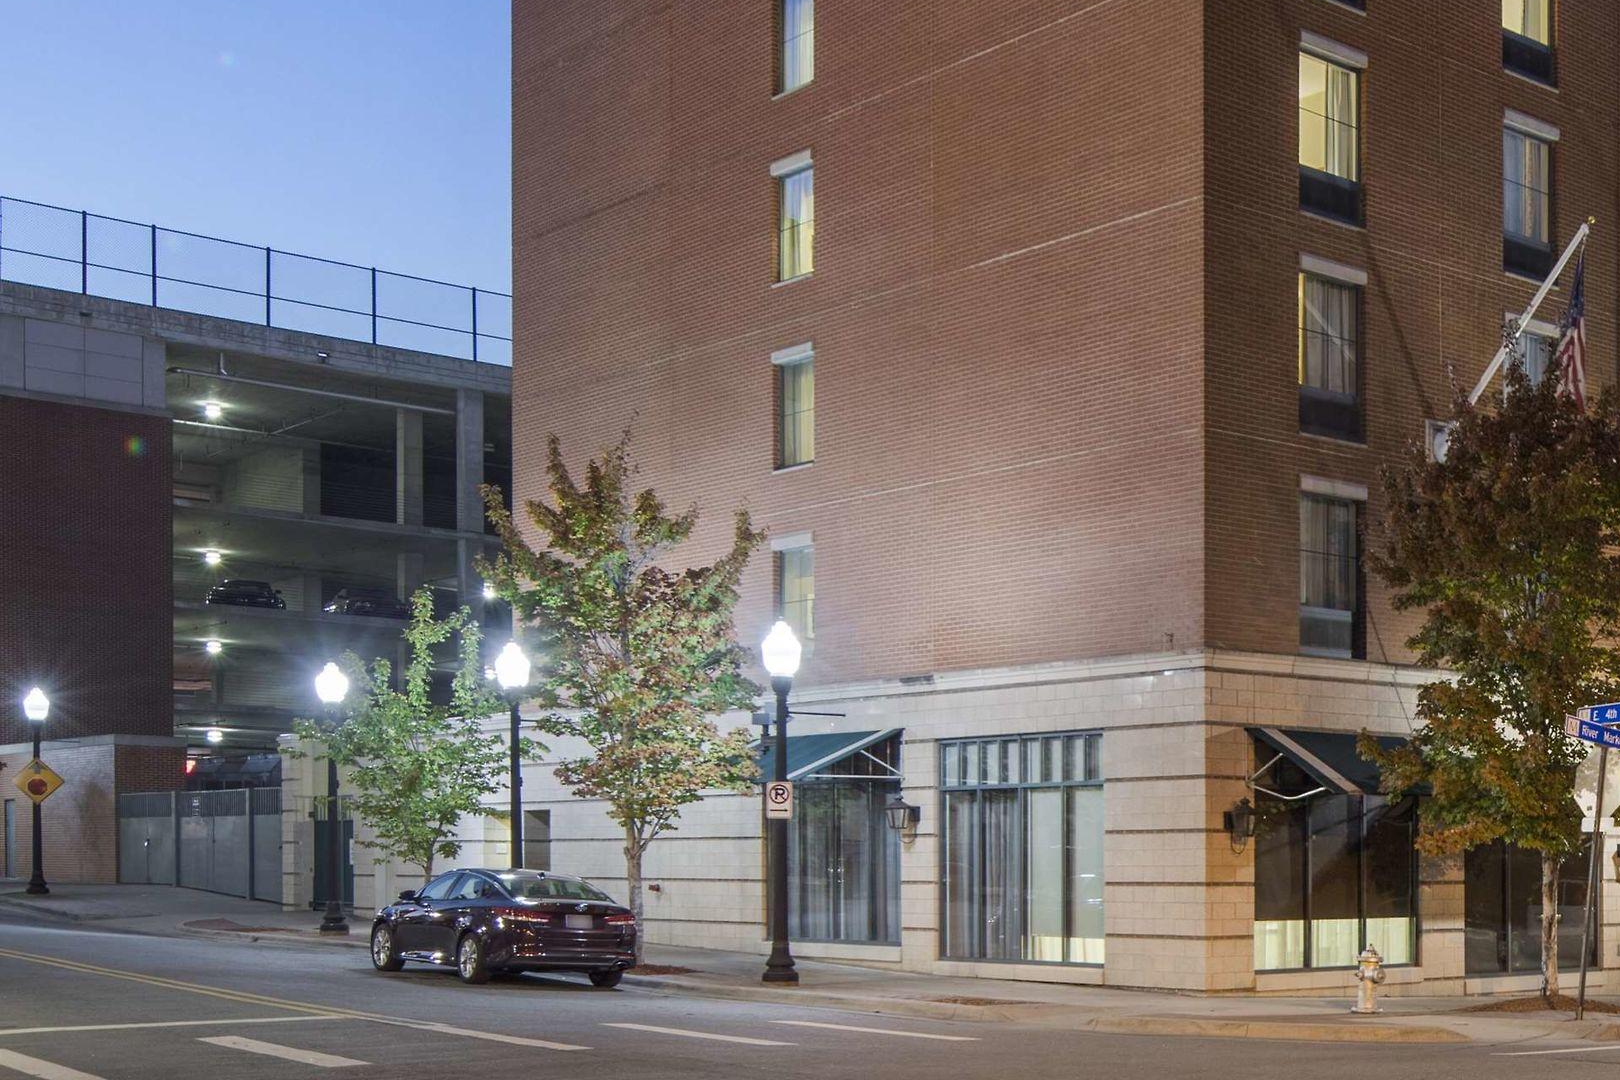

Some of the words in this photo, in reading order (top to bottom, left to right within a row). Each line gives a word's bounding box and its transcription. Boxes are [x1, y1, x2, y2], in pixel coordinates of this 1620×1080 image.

[1594, 710, 1599, 721] E
[1605, 708, 1618, 720] 4th
[1582, 724, 1598, 739] River
